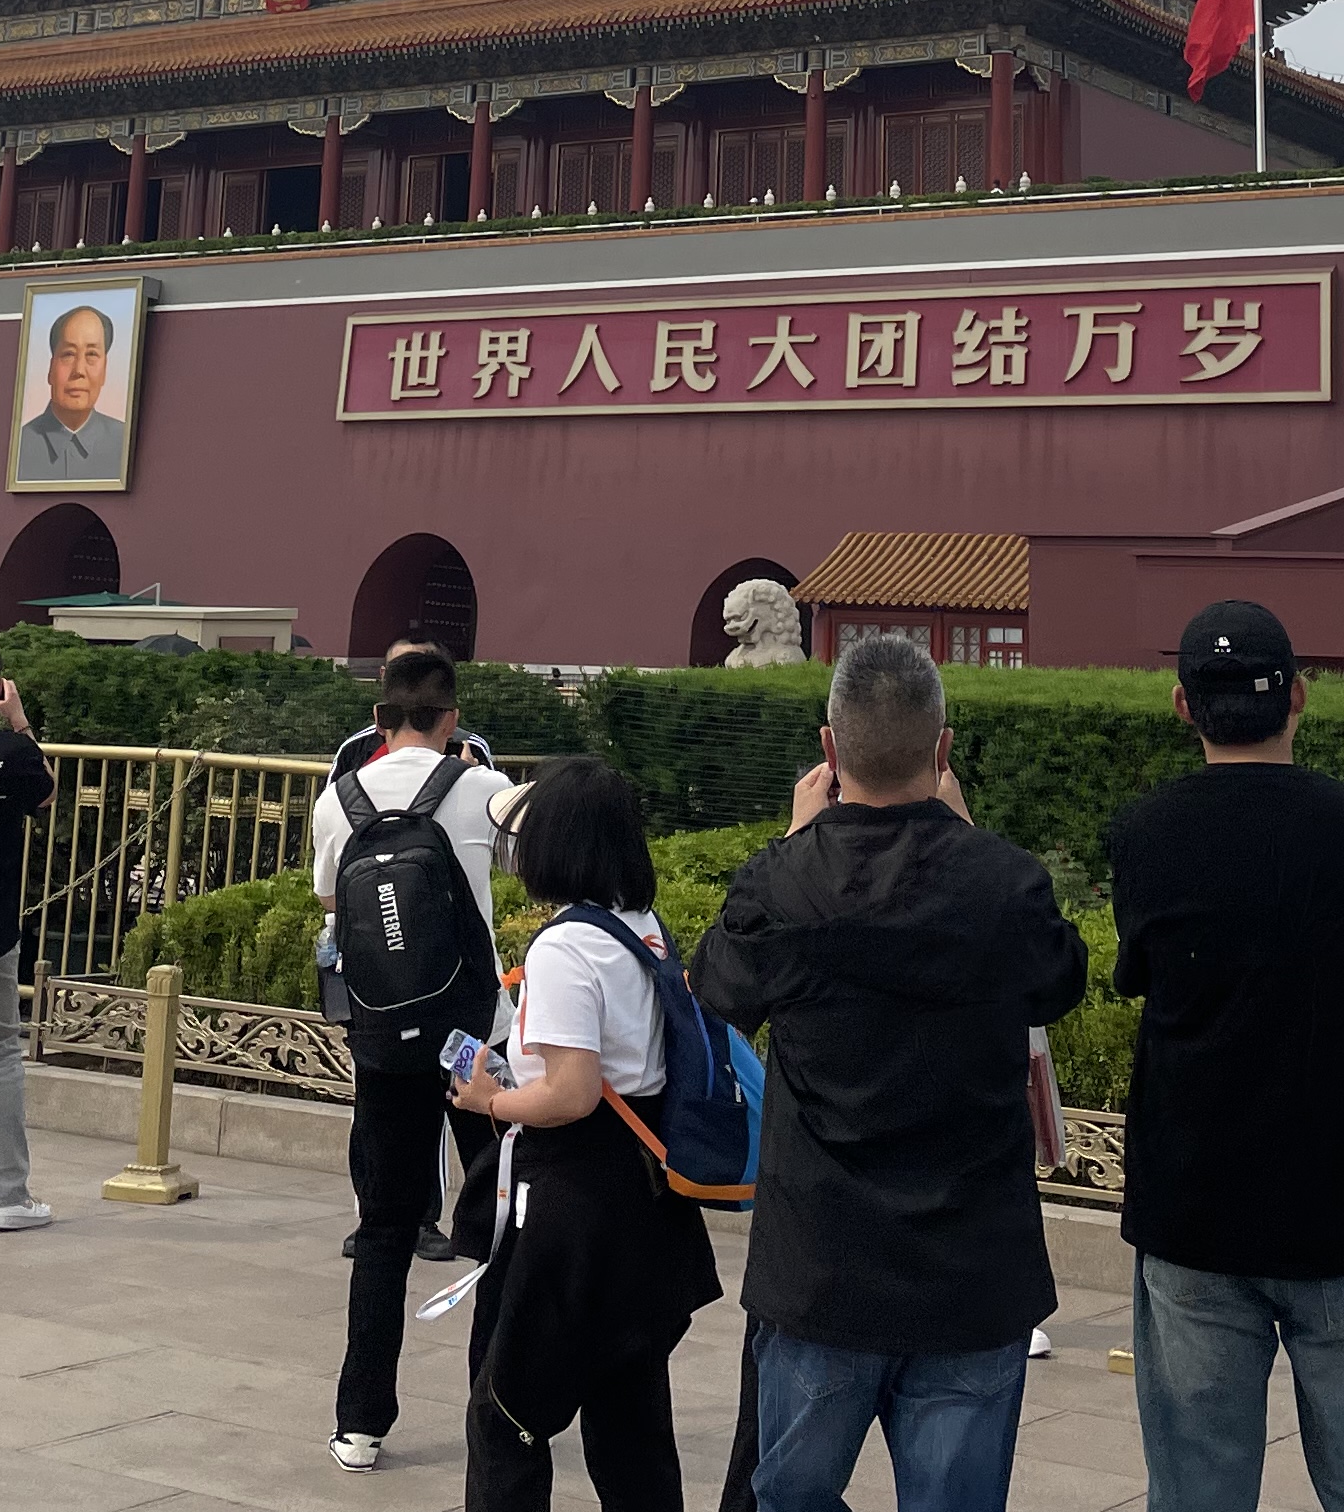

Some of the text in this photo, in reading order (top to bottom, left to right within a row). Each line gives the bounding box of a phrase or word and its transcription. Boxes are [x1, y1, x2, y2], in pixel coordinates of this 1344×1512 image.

[388, 298, 1263, 401] 世界人民大团结万岁
[377, 882, 406, 952] BUTTERFLY
